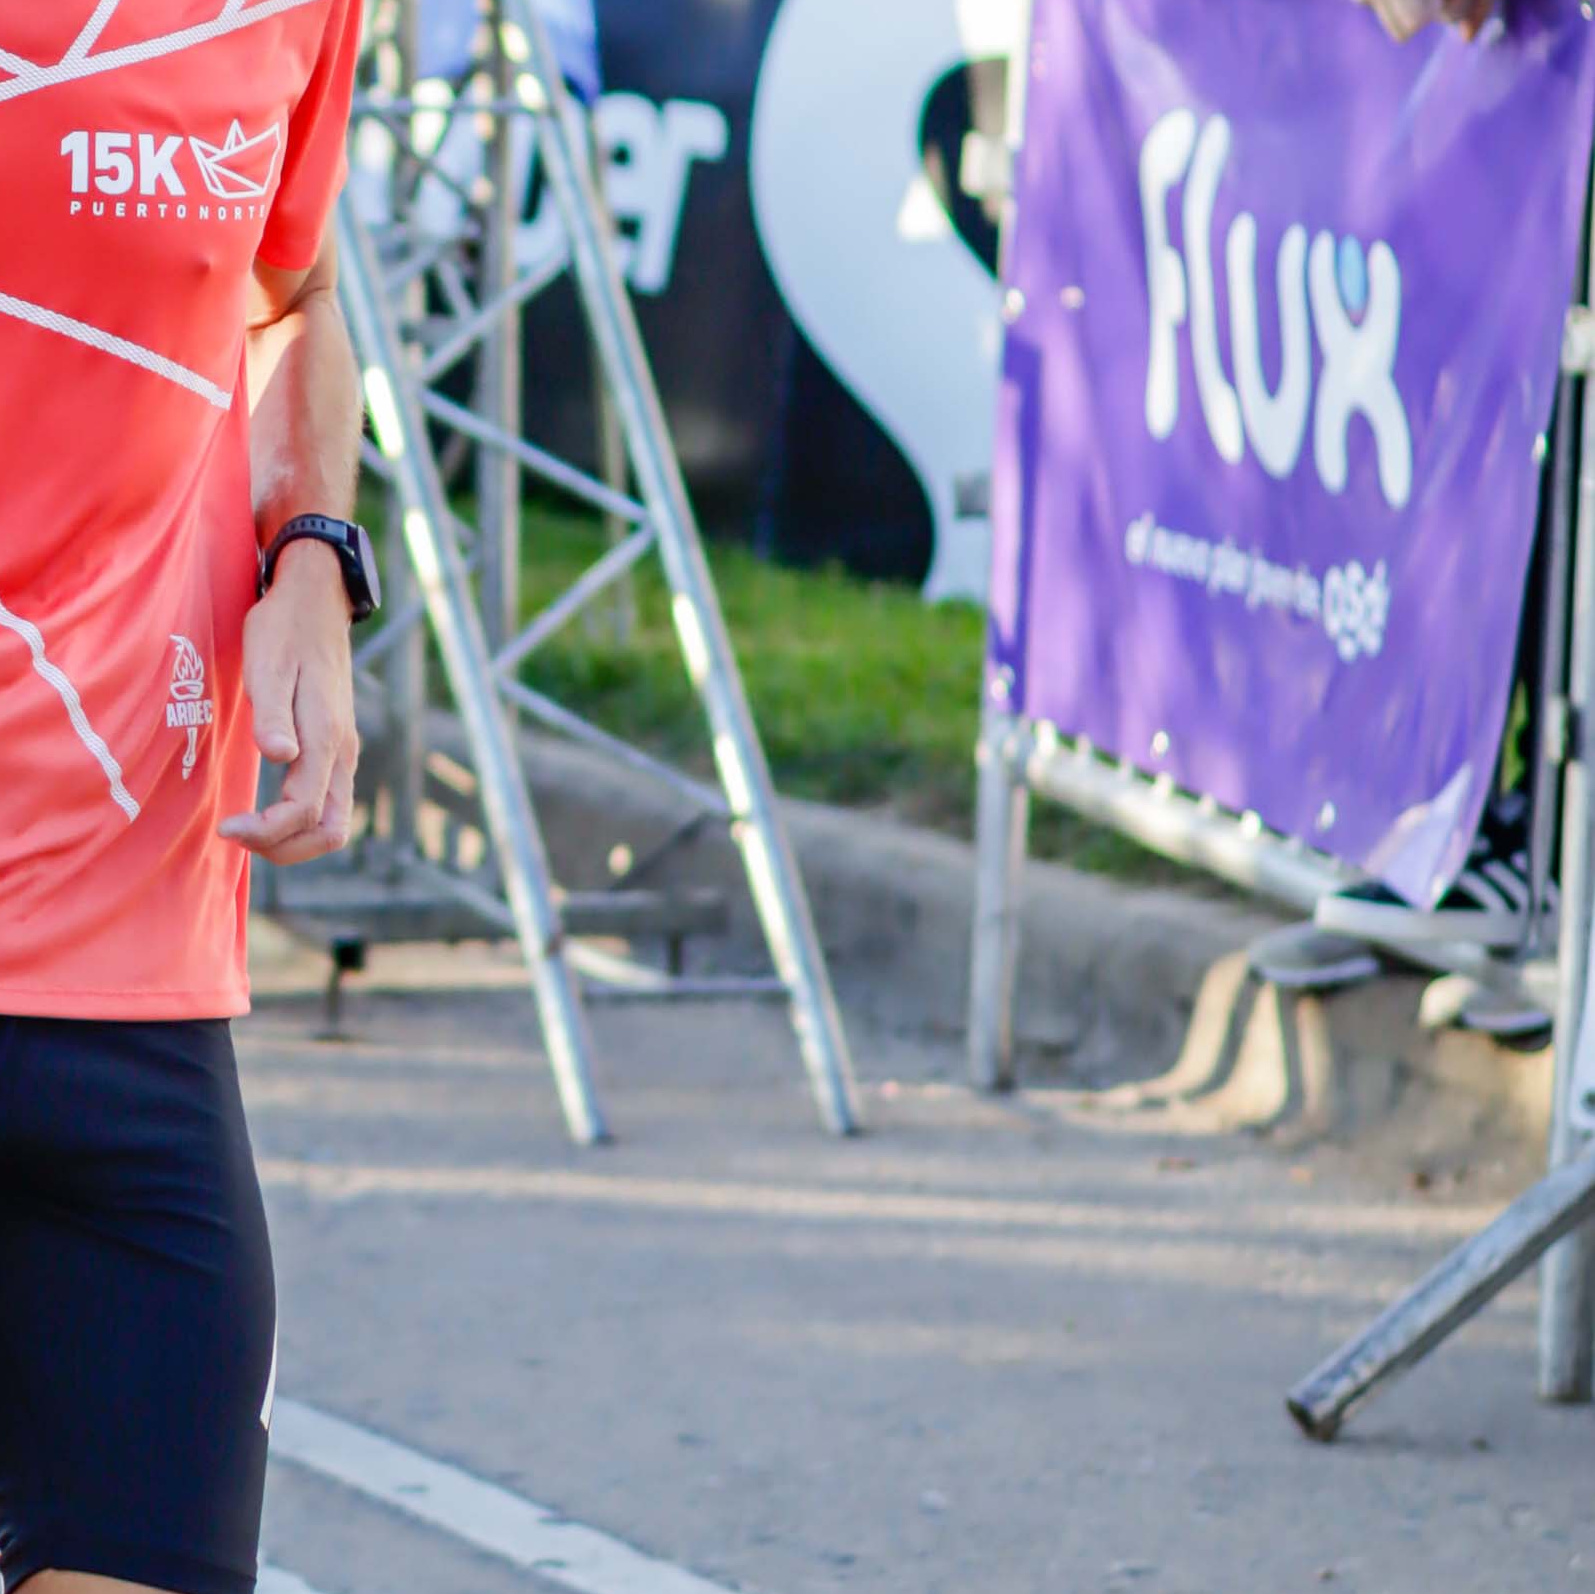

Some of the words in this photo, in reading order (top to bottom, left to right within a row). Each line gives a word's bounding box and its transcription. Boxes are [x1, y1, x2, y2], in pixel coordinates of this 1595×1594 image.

[60, 131, 187, 196] 15K
[70, 201, 187, 219] PUERTO
[166, 699, 214, 728] ARDEC
